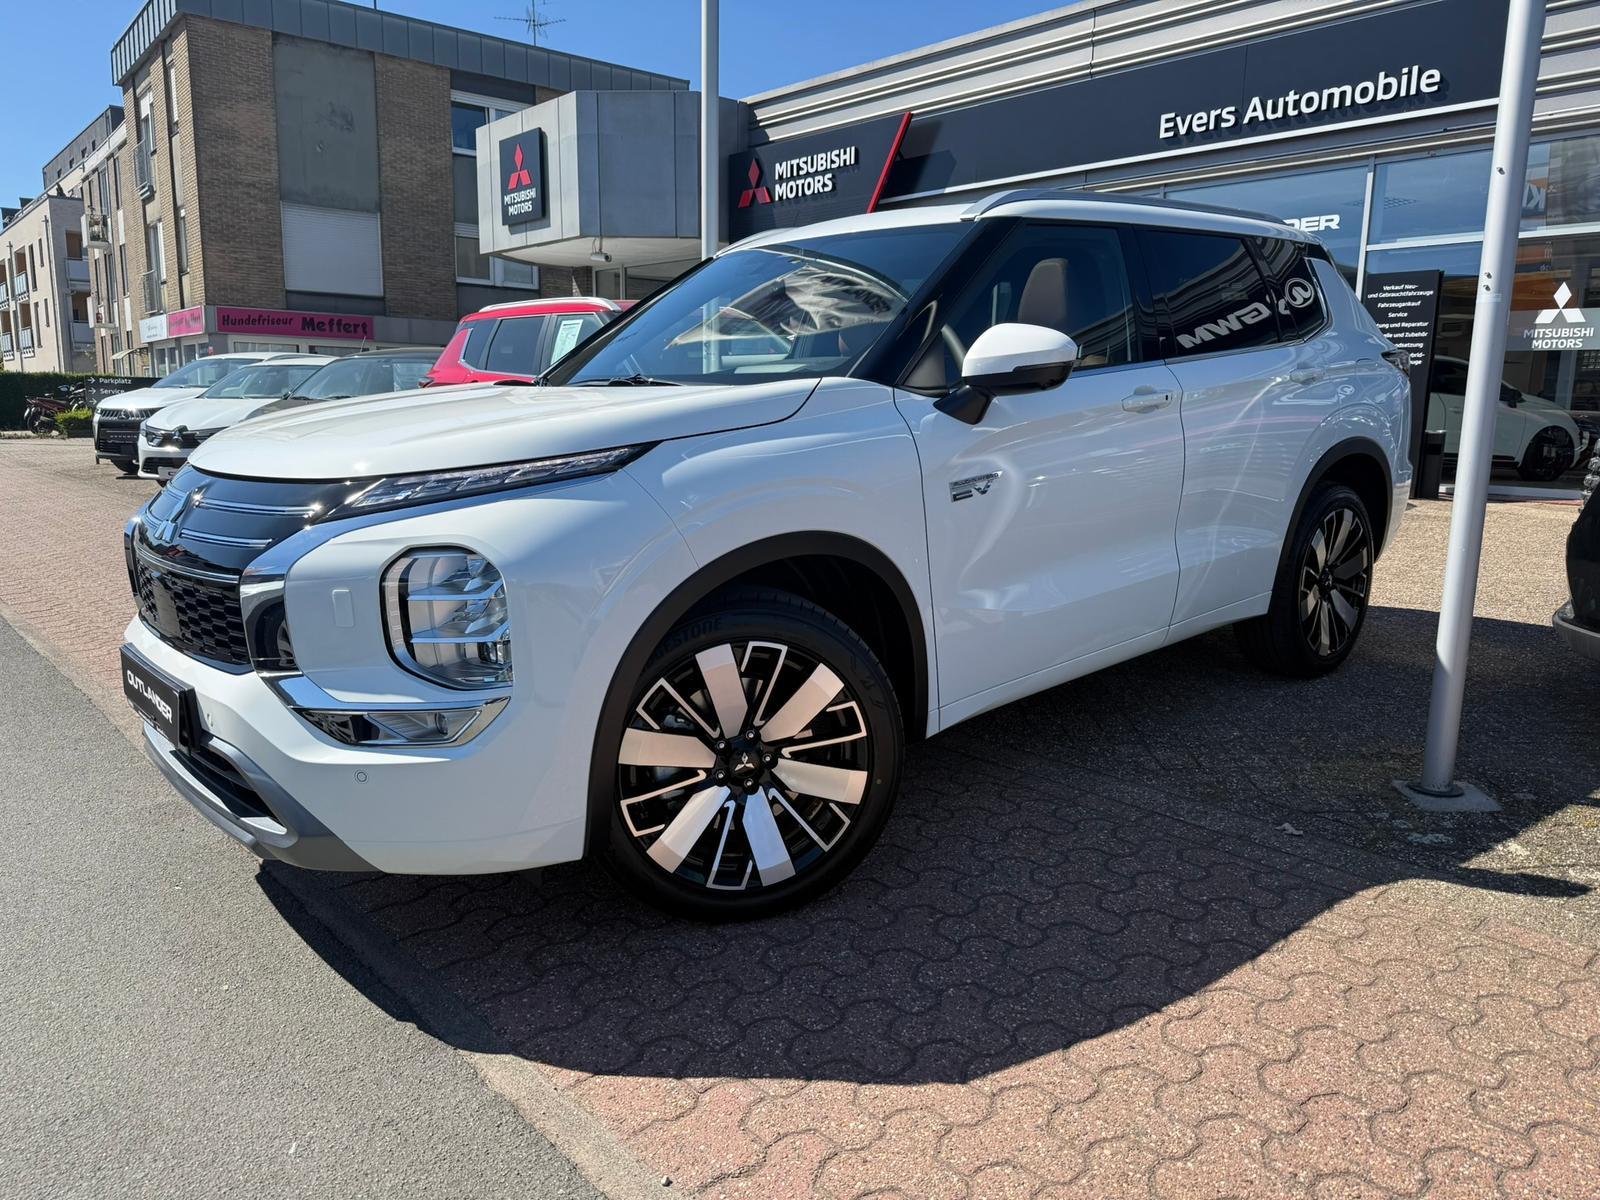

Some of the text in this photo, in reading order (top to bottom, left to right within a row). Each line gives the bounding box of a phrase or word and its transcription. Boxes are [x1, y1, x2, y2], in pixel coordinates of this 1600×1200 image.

[1159, 65, 1441, 139] Evers Automobile
[774, 146, 856, 180] MITSUBISHI
[503, 187, 537, 206] MITSUBISHI
[774, 173, 833, 202] MOTORS
[508, 201, 533, 216] MOTORS
[1377, 300, 1421, 308] Fahrzeugankauf
[221, 314, 369, 335] Hundefriseur Meffert
[1523, 327, 1595, 339] MITSUBISHI
[1531, 338, 1583, 350] MOTORS
[99, 377, 132, 385] Parkplatz
[126, 669, 173, 724] OUTLANDER
